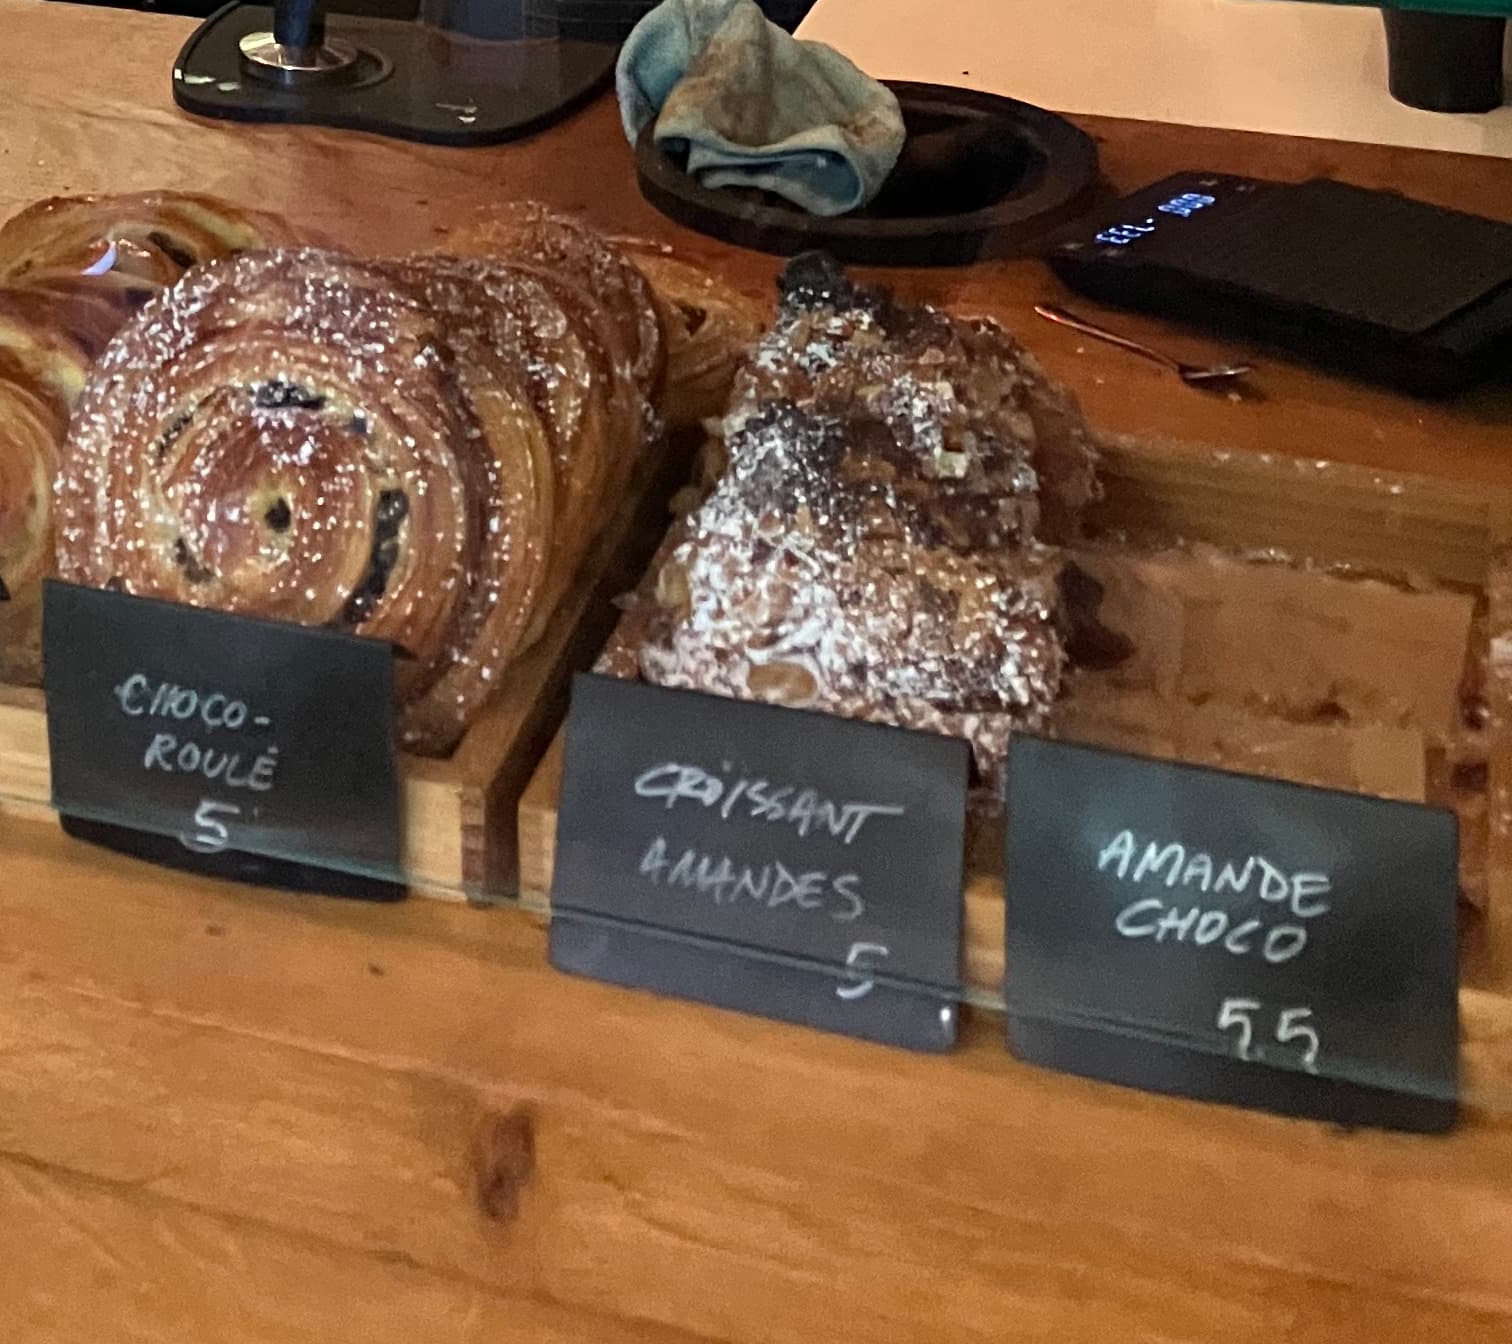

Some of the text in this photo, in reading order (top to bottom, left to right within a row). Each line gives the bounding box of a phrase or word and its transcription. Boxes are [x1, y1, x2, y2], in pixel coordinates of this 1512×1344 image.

[635, 760, 905, 844] CROISSANT
[639, 837, 865, 922] AMANDES
[1097, 829, 1332, 918] AMANDE
[835, 942, 888, 999] 5
[1116, 899, 1309, 963] CHOCO
